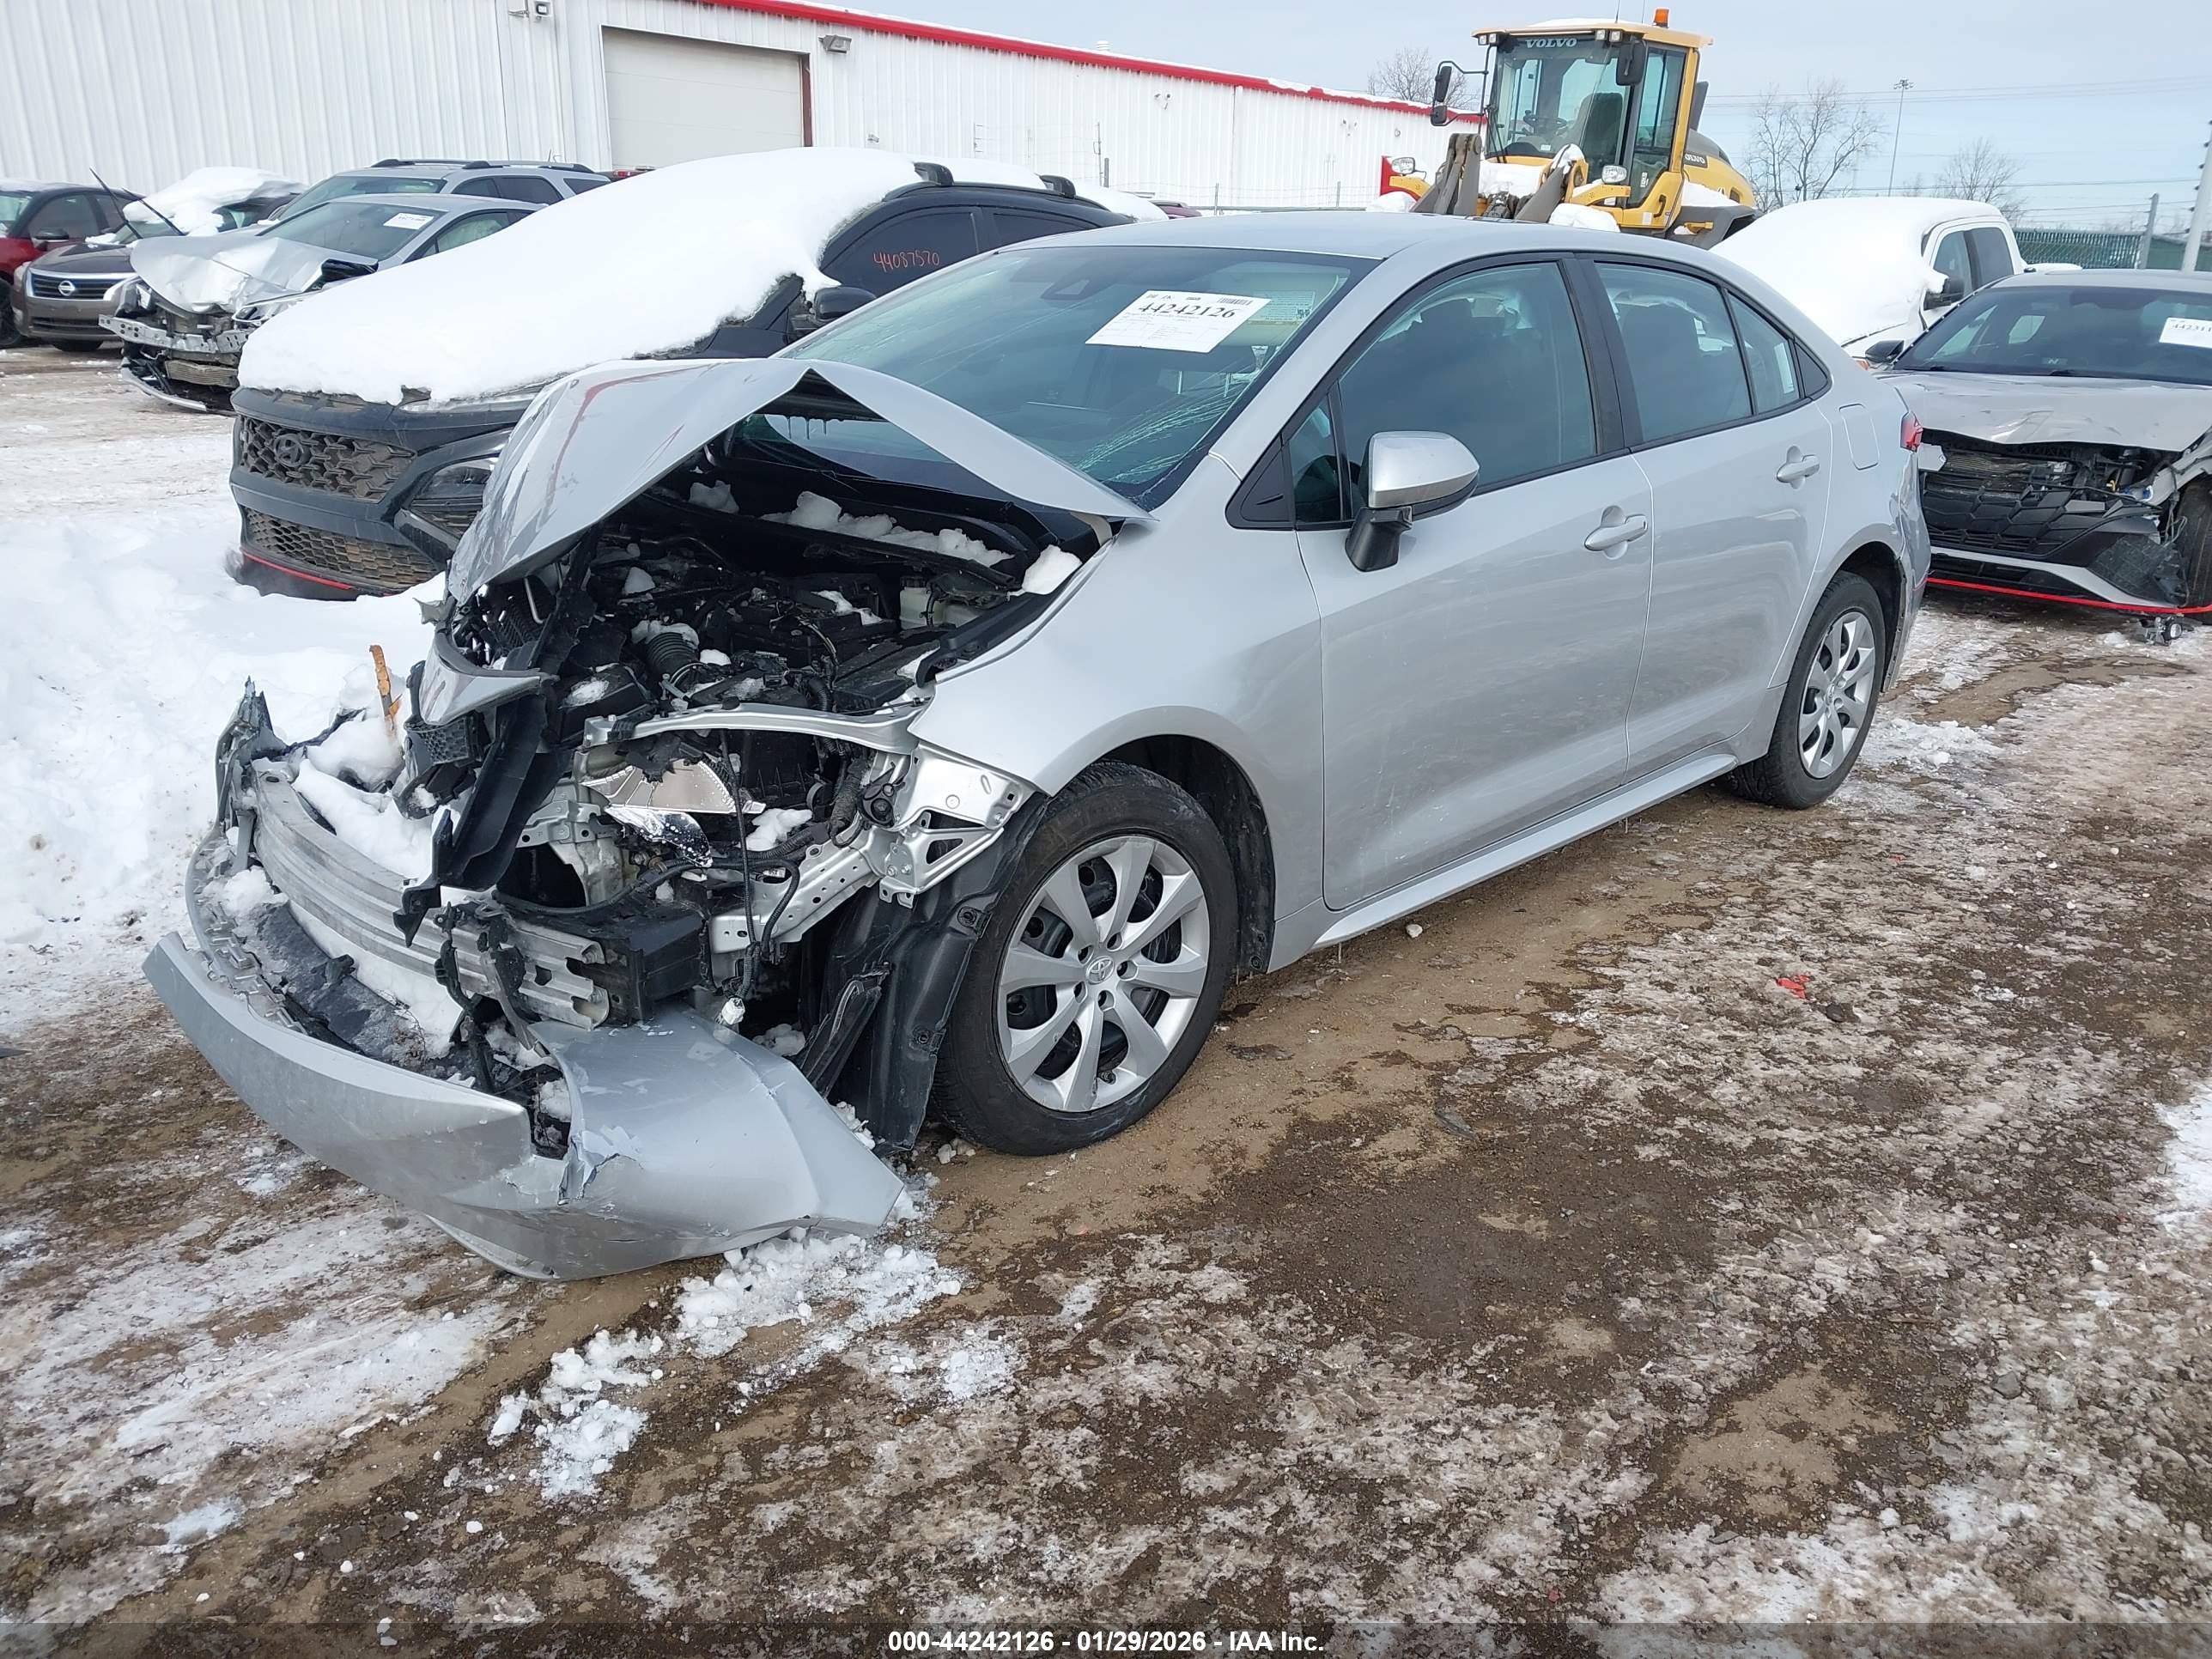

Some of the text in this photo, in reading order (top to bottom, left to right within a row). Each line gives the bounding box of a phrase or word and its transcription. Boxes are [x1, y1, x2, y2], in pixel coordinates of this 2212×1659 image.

[1525, 38, 1577, 49] VOLVO
[1685, 153, 1706, 164] OLVO
[873, 249, 940, 272] 44087570
[1139, 302, 1237, 319] 44242126
